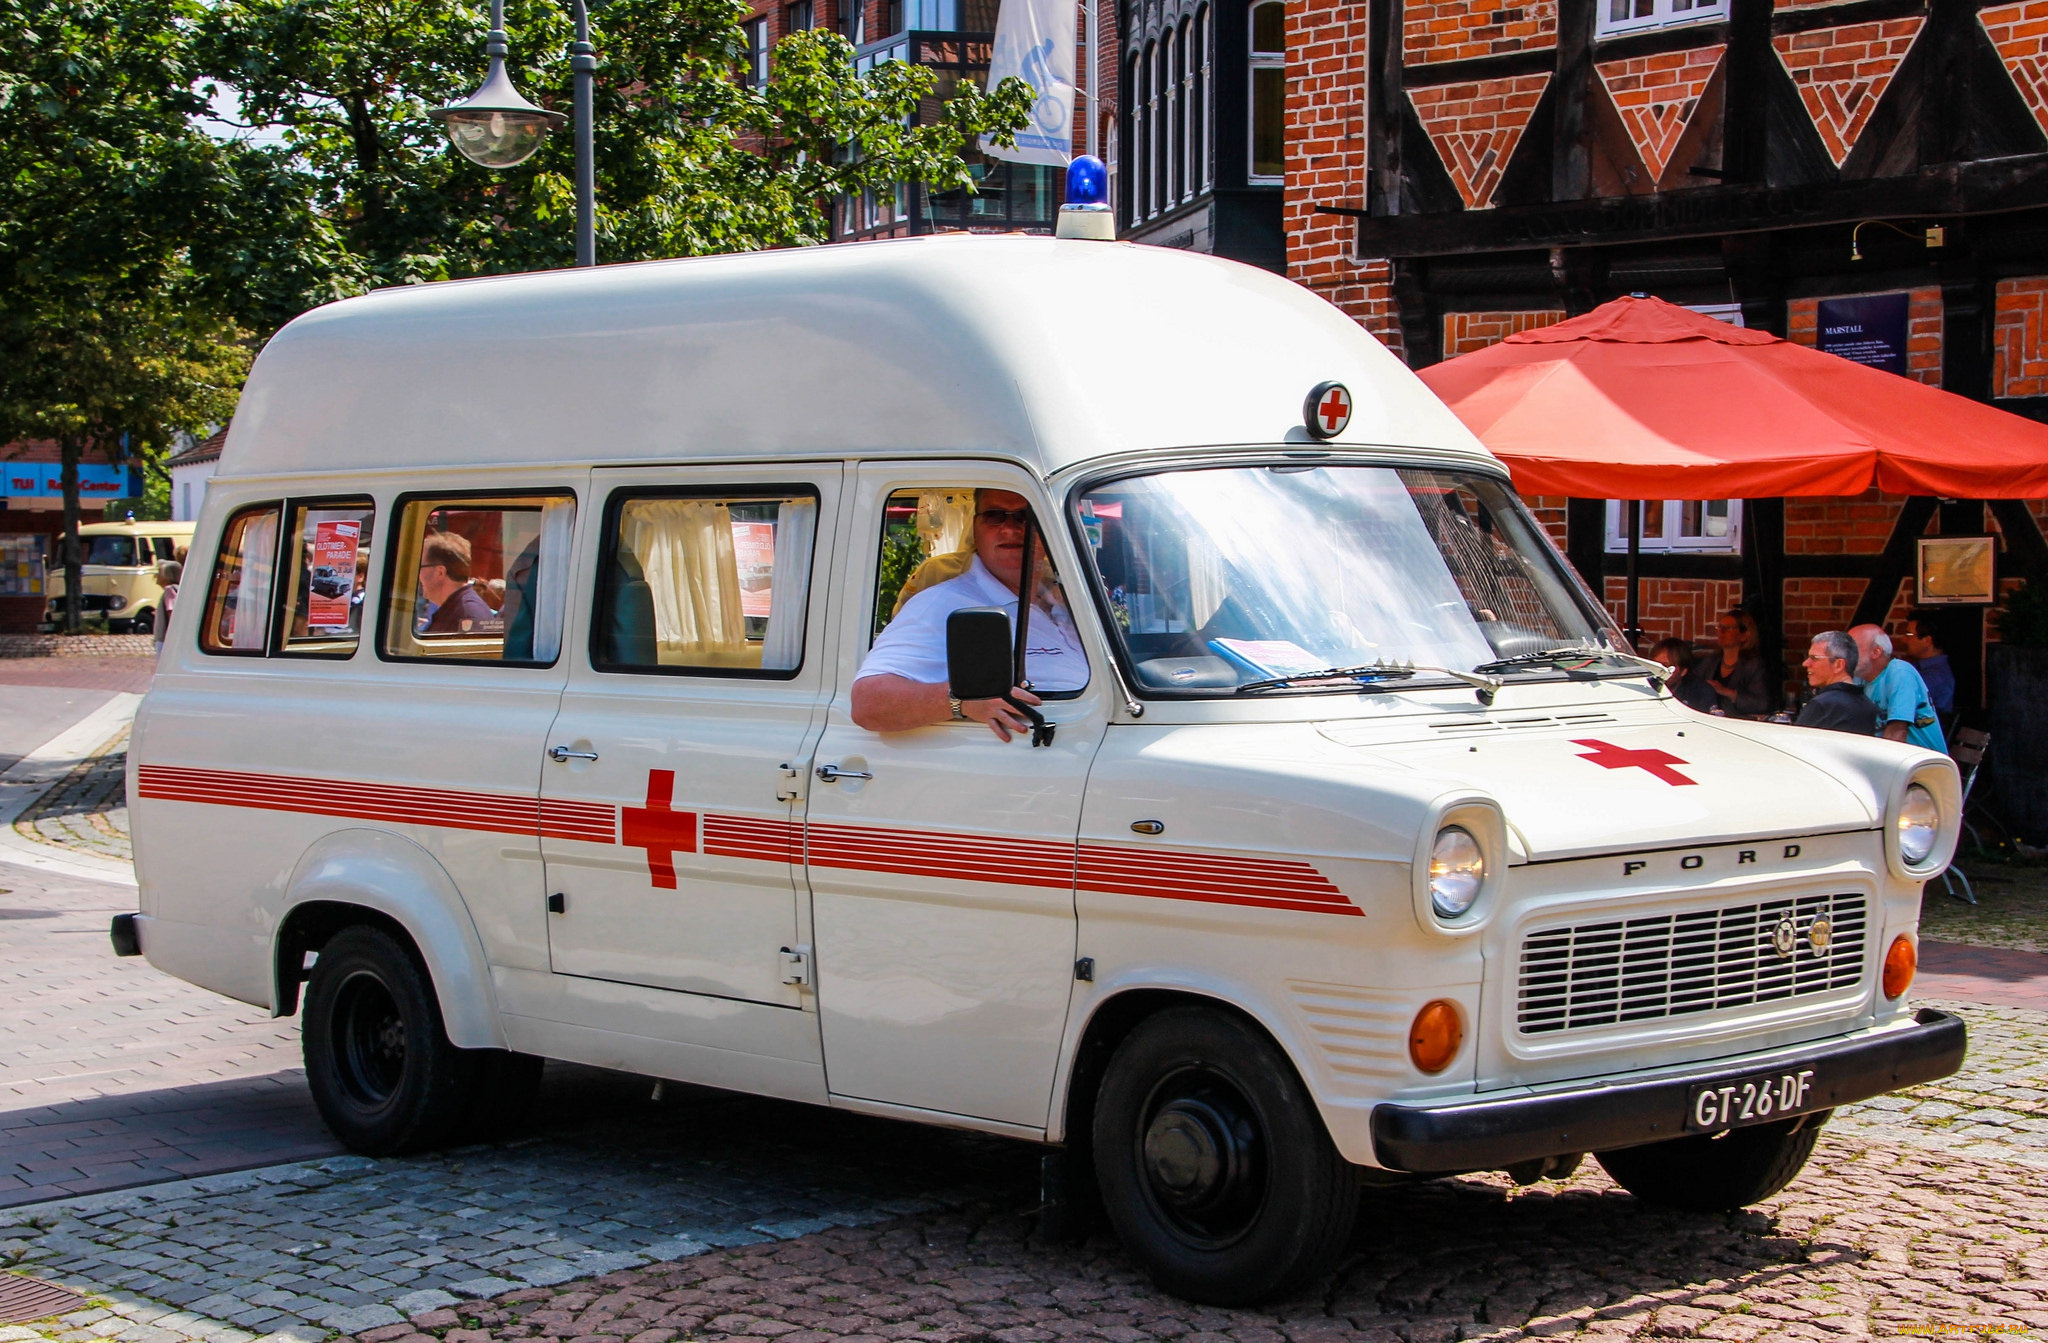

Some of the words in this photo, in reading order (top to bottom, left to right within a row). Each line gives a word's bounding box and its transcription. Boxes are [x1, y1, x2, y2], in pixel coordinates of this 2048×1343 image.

[1825, 325, 1863, 335] MARSTALL
[12, 478, 35, 490] TUI
[326, 551, 352, 560] PARADE
[1623, 844, 1801, 875] FORD
[1695, 1070, 1814, 1127] GT-26-DF
